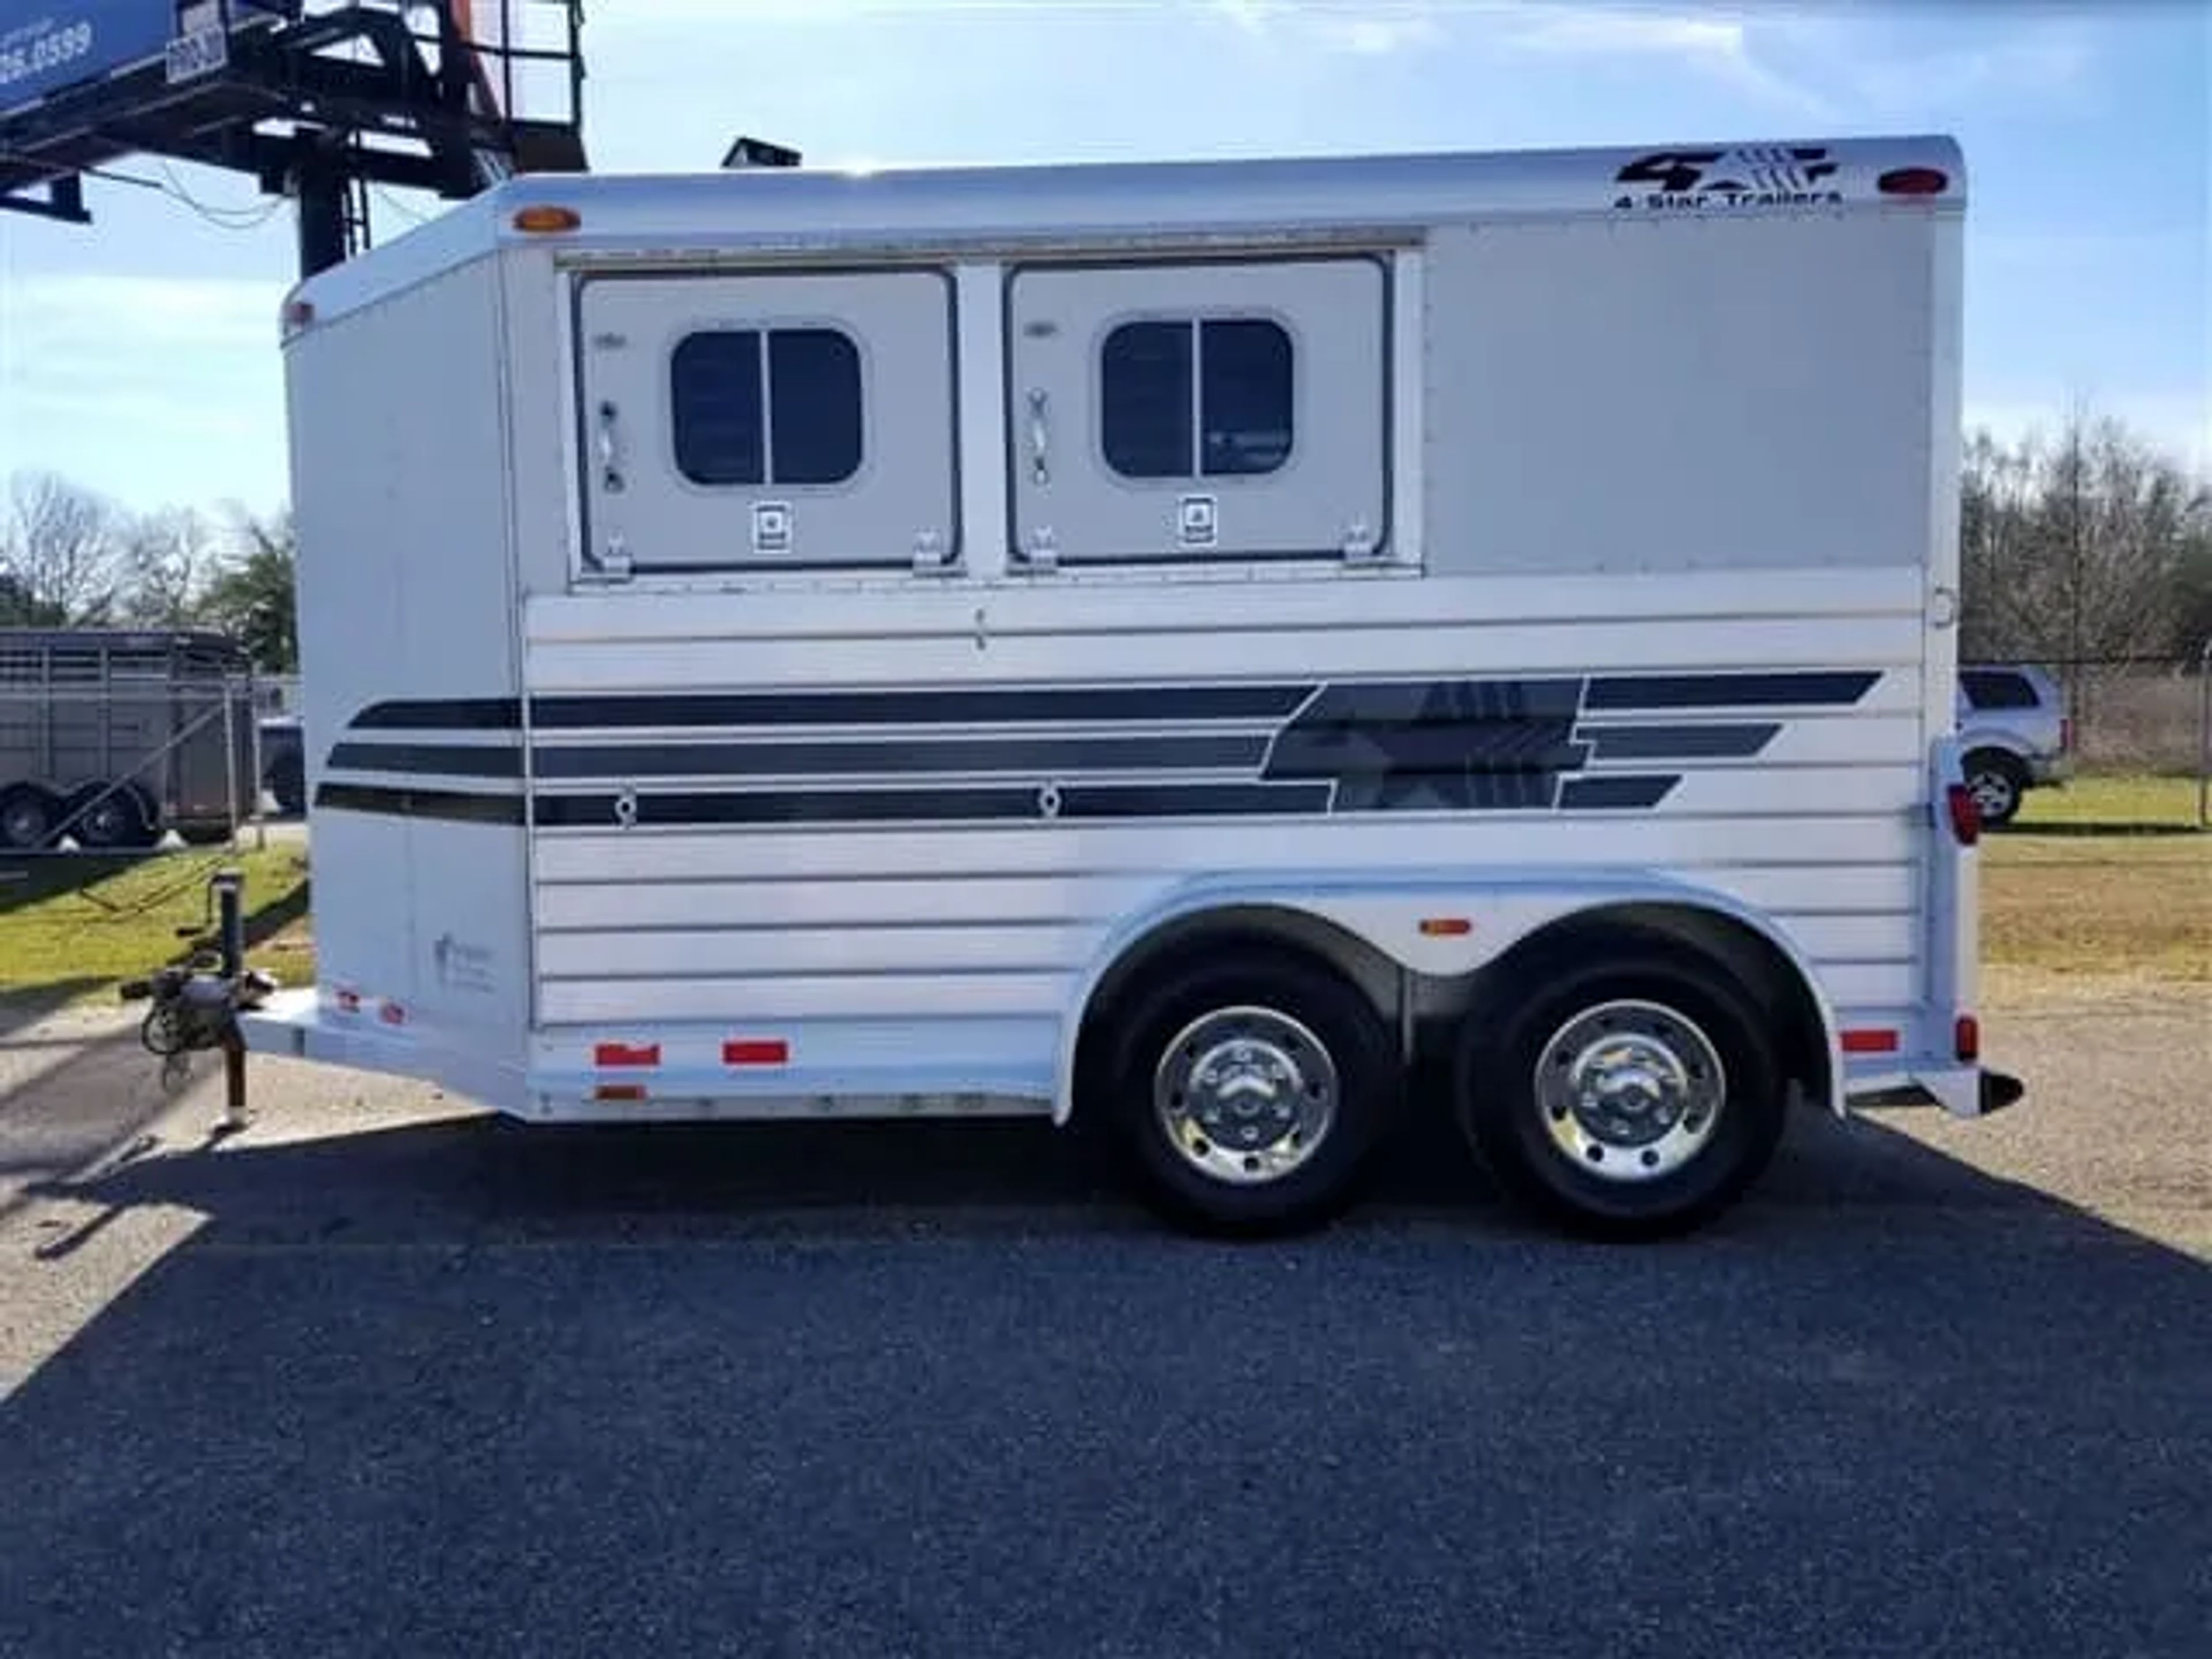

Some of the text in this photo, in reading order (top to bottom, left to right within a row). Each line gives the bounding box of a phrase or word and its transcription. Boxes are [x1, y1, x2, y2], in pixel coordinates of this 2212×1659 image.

[1614, 191, 1843, 209] 4 Star Trailers
